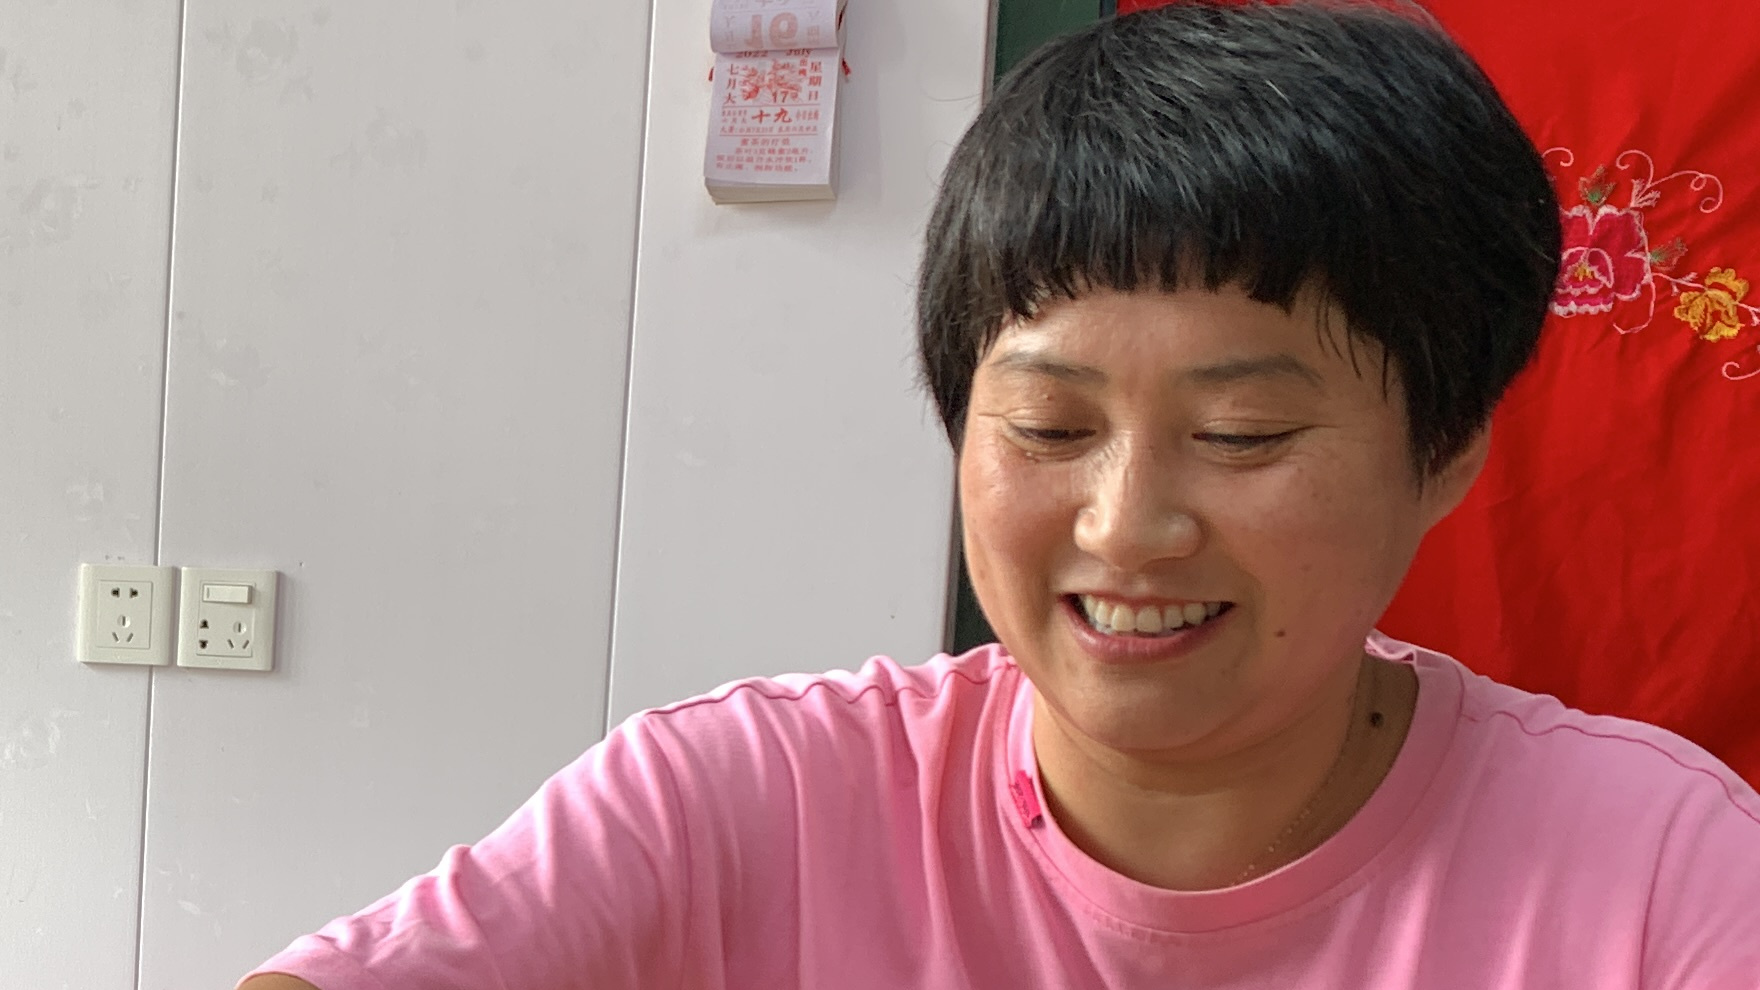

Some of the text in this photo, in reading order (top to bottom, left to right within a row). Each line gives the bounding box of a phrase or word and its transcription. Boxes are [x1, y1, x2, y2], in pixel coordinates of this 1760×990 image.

[808, 61, 822, 101] 星期日
[752, 108, 793, 124] 十九
